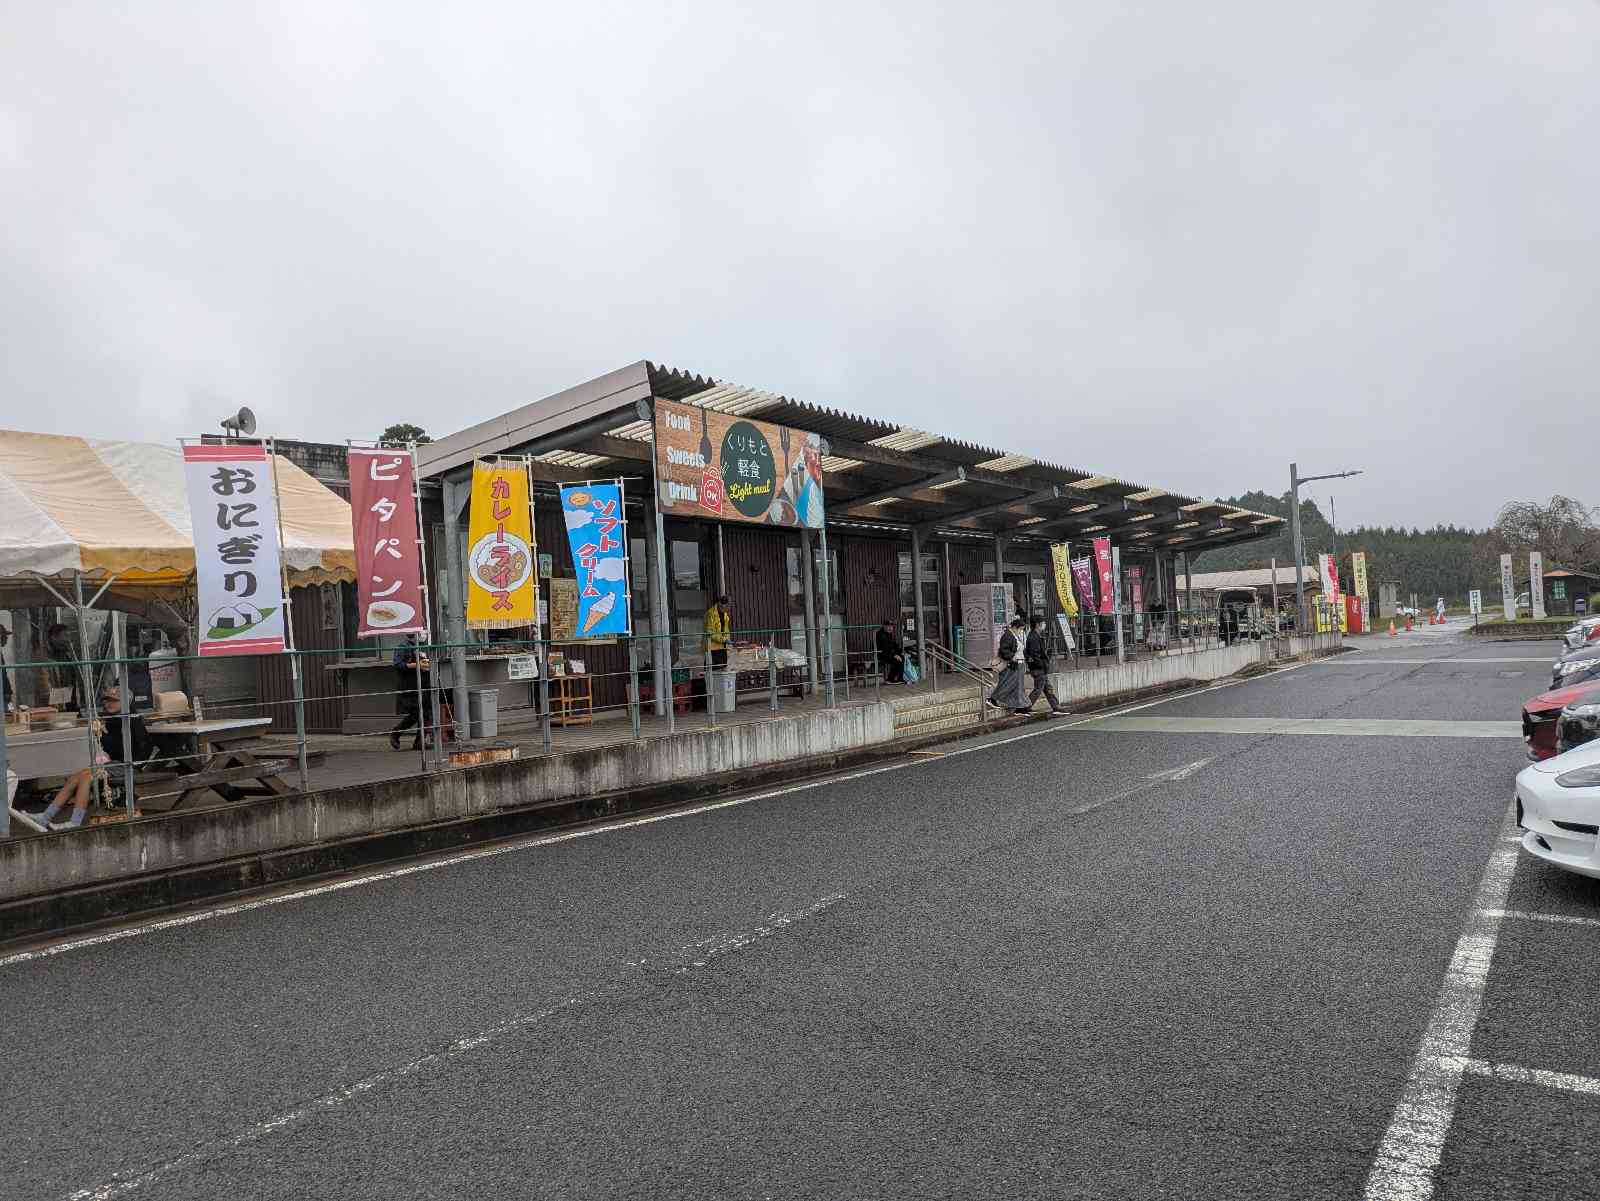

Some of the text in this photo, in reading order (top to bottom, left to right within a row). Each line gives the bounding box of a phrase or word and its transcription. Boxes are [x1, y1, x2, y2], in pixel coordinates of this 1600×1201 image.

[666, 446, 706, 469] Sweets
[727, 433, 768, 457] くりもと
[737, 458, 761, 479] 軽食
[729, 482, 752, 502] Light
[753, 479, 771, 496] meal
[210, 466, 263, 598] おにぎり
[370, 457, 403, 597] ピタパン
[490, 476, 514, 612] カレーライス
[592, 499, 619, 553] ソフト
[575, 543, 600, 598] クリーム
